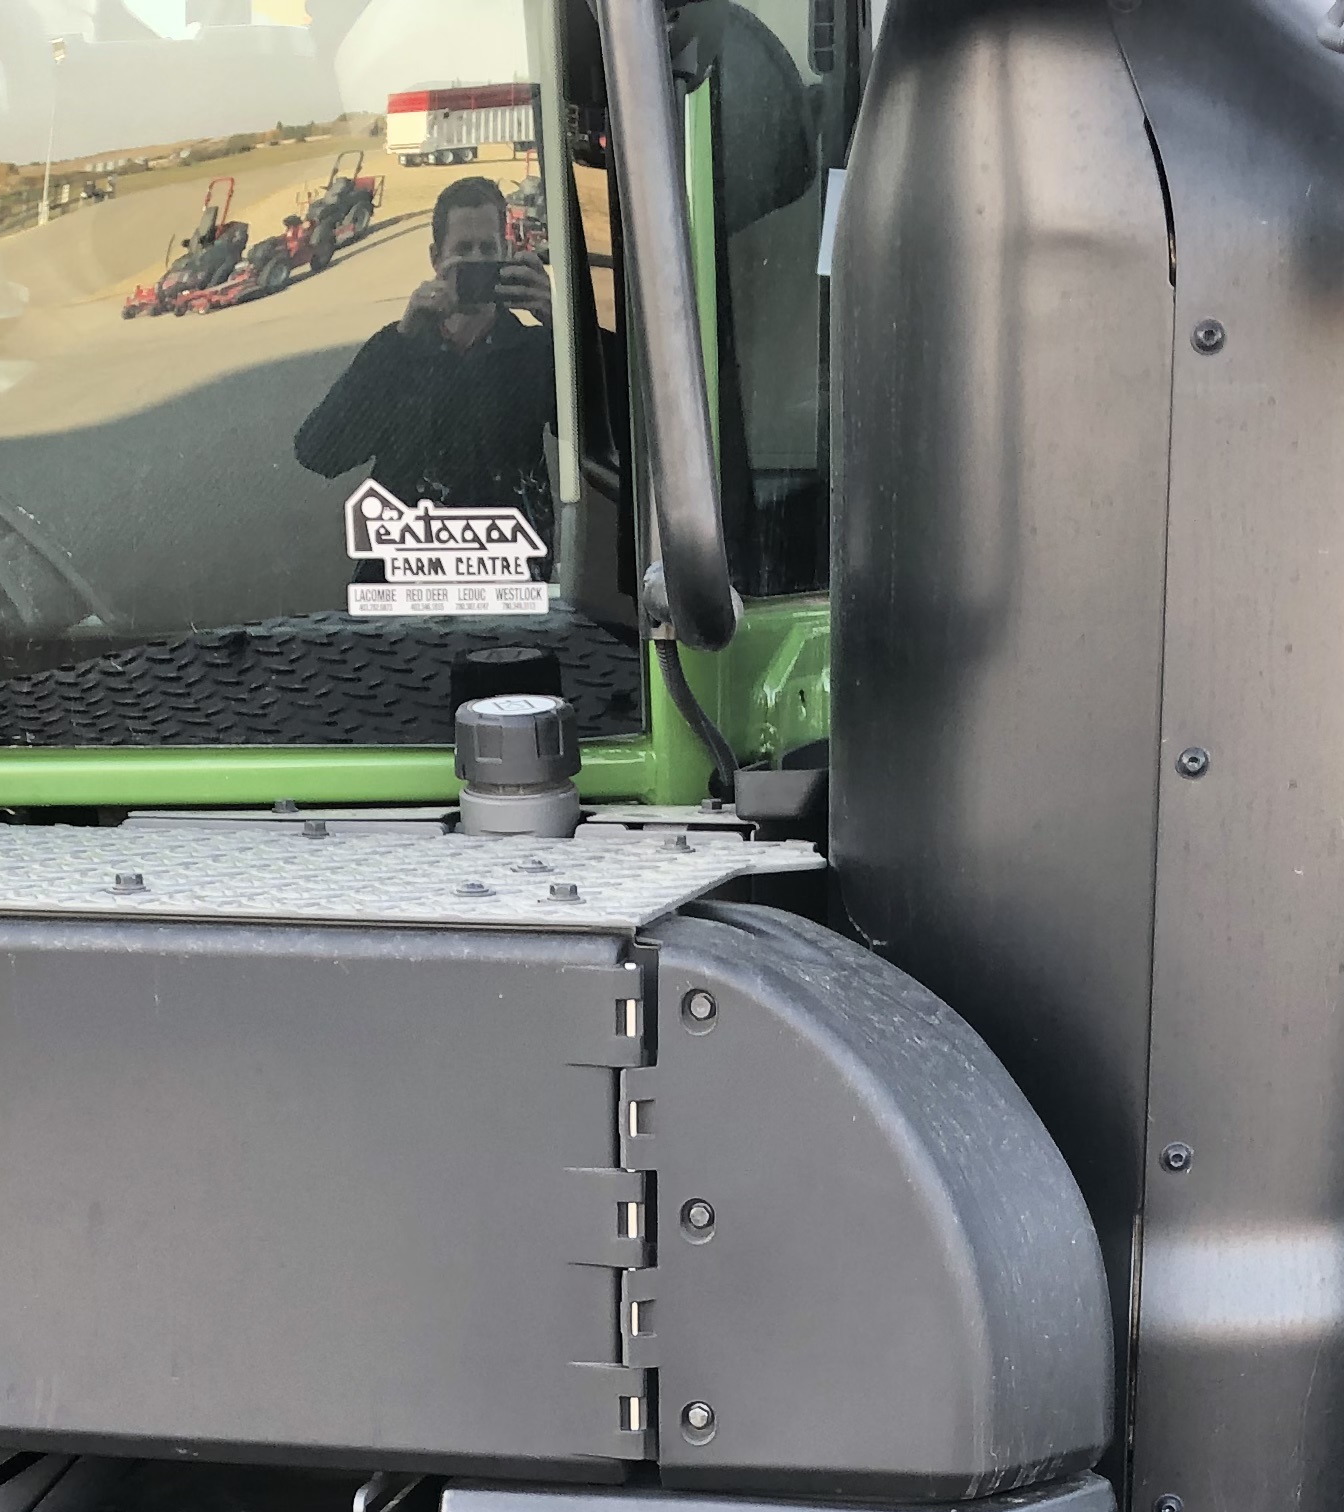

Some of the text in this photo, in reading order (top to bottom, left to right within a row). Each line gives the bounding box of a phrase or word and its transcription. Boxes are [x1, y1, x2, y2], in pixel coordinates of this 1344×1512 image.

[392, 557, 524, 576] FARM CENTRE
[354, 587, 542, 602] LACOMBE RED DEER LEDUC WESTLOCK
